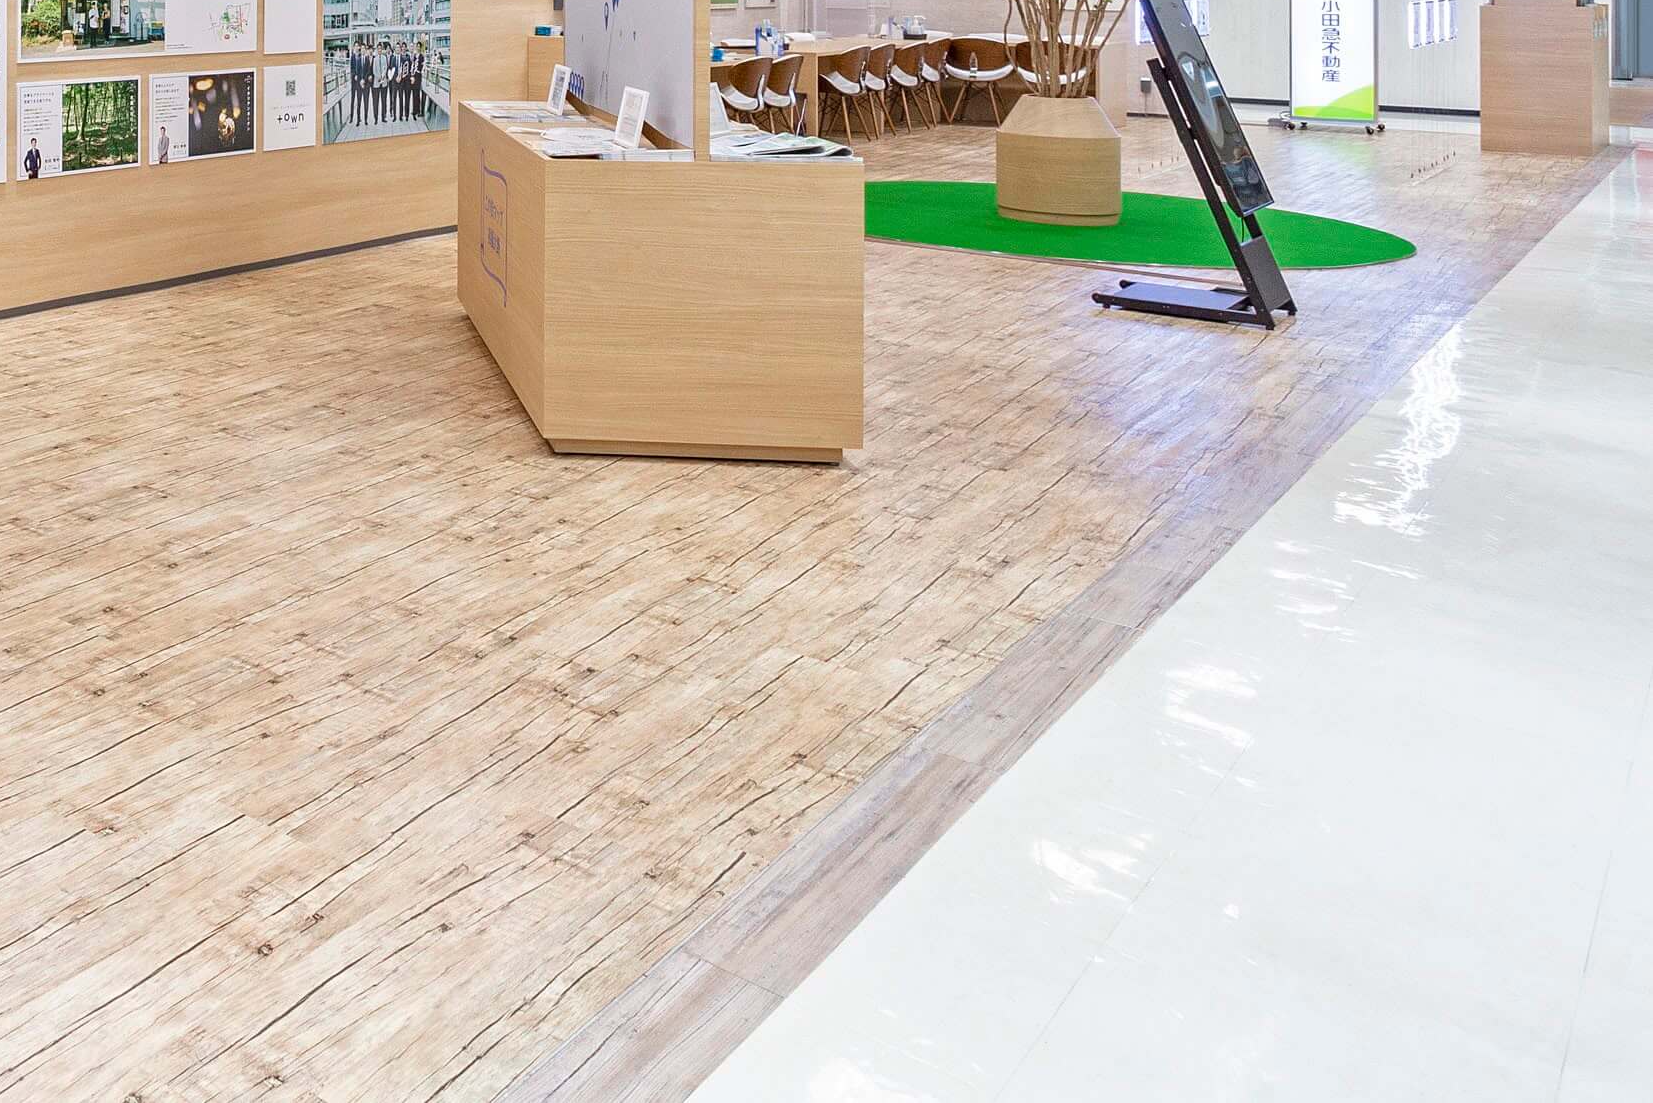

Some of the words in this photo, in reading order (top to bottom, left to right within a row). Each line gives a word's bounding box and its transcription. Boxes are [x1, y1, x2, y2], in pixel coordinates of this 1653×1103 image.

[1321, 0, 1341, 83] 小田急不動産
